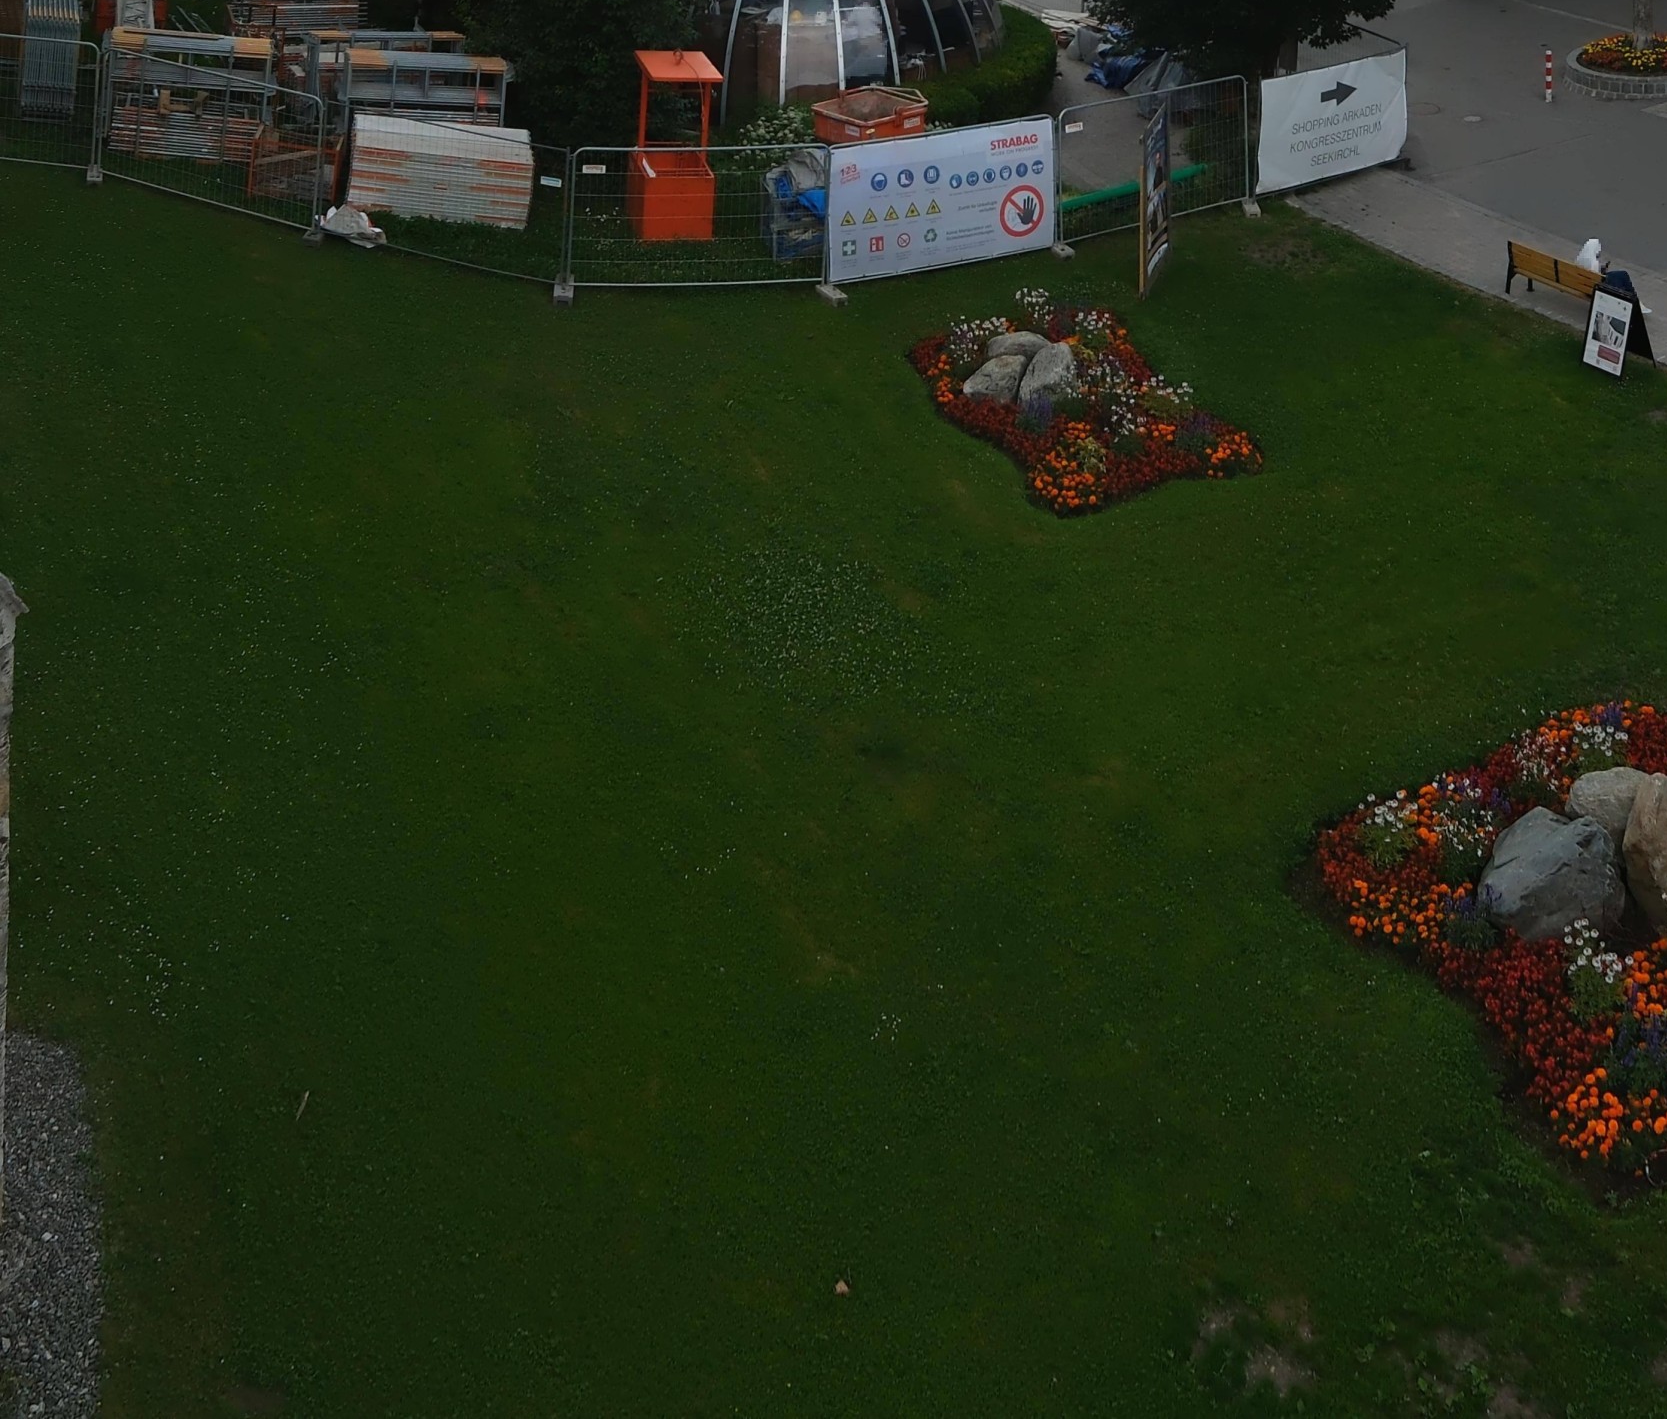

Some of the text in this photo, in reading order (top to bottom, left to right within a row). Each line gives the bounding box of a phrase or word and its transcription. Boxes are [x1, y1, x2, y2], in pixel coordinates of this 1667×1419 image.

[1292, 104, 1382, 135] SHOPPING ARKADEN
[990, 134, 1039, 151] STRABAG
[1290, 121, 1382, 153] KONGRESSZENTRUM
[1310, 145, 1360, 167] SEEKIRCHL
